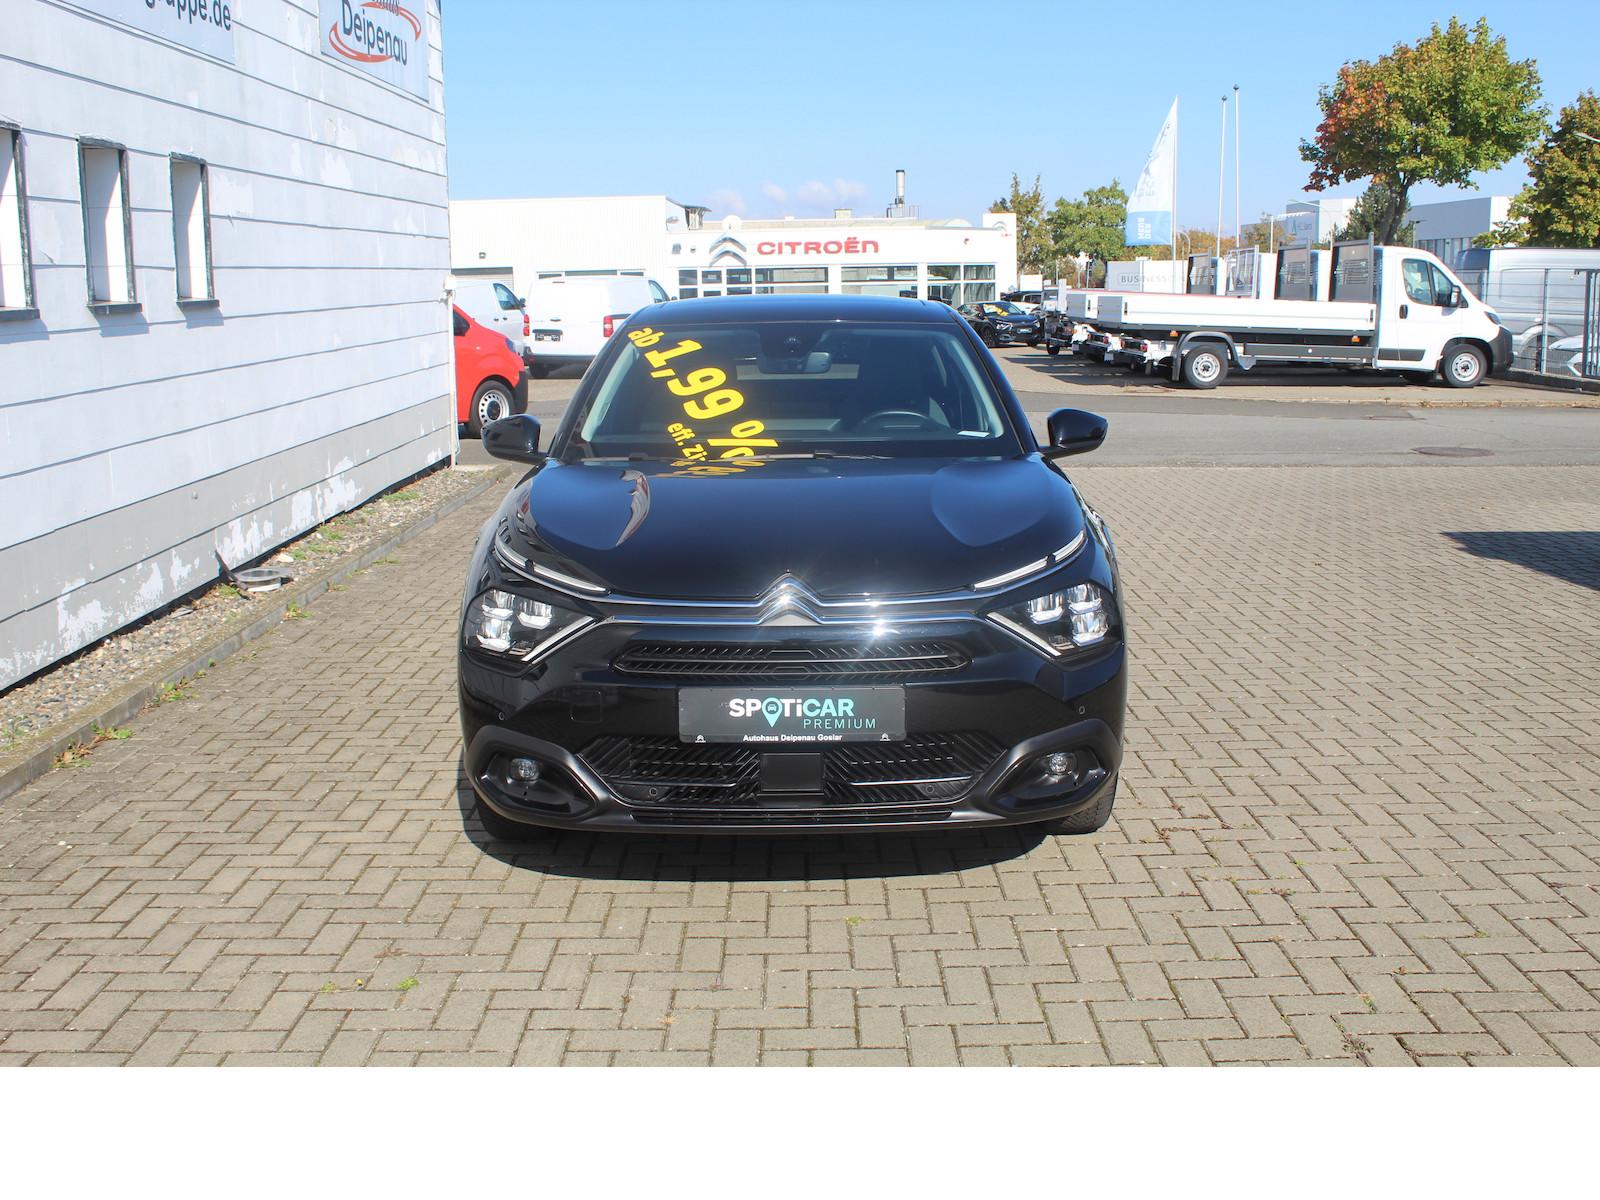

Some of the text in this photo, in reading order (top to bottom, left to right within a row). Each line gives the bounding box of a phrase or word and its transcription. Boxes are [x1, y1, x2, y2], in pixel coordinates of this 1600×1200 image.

[342, 0, 408, 66] Deipenau
[757, 237, 879, 255] CITROËN
[627, 328, 664, 347] ab
[667, 423, 708, 461] eff. Zi
[803, 719, 876, 729] PREMIUM
[743, 734, 779, 742] Autohaus
